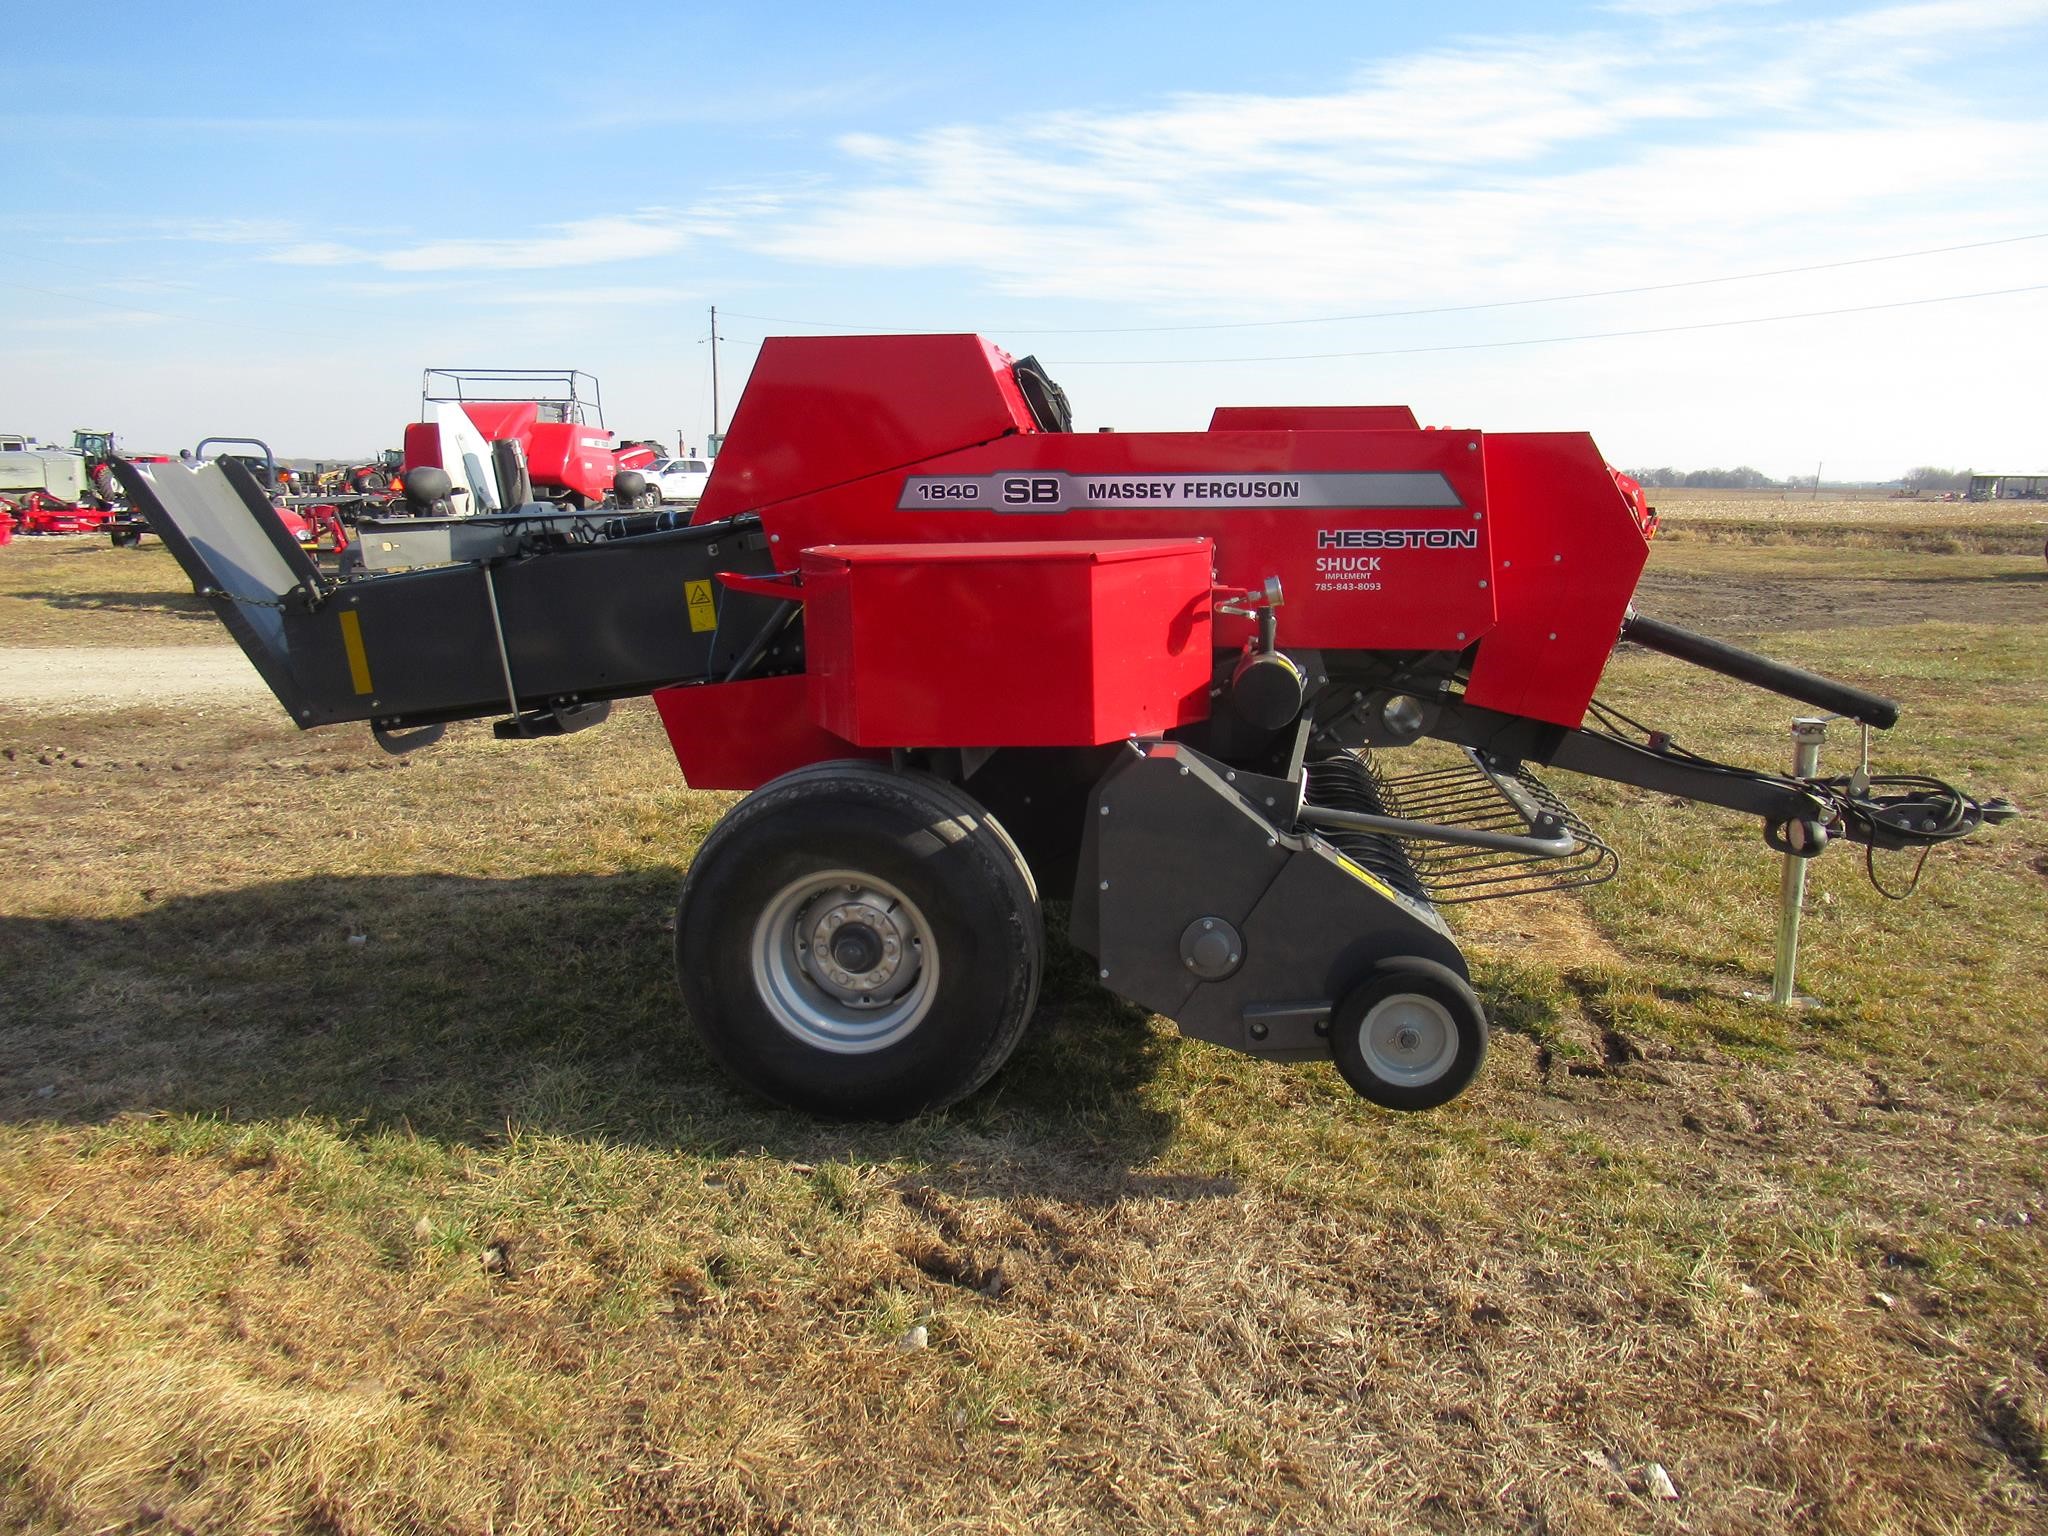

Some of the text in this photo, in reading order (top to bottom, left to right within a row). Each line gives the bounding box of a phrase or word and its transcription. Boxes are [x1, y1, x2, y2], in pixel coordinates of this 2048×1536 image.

[917, 477, 1300, 505] 1840 SB MASSEY FERGUSON
[1317, 529, 1478, 549] HESSTON
[1316, 557, 1382, 572] SHUCK
[1315, 583, 1382, 591] 785-843-8093
